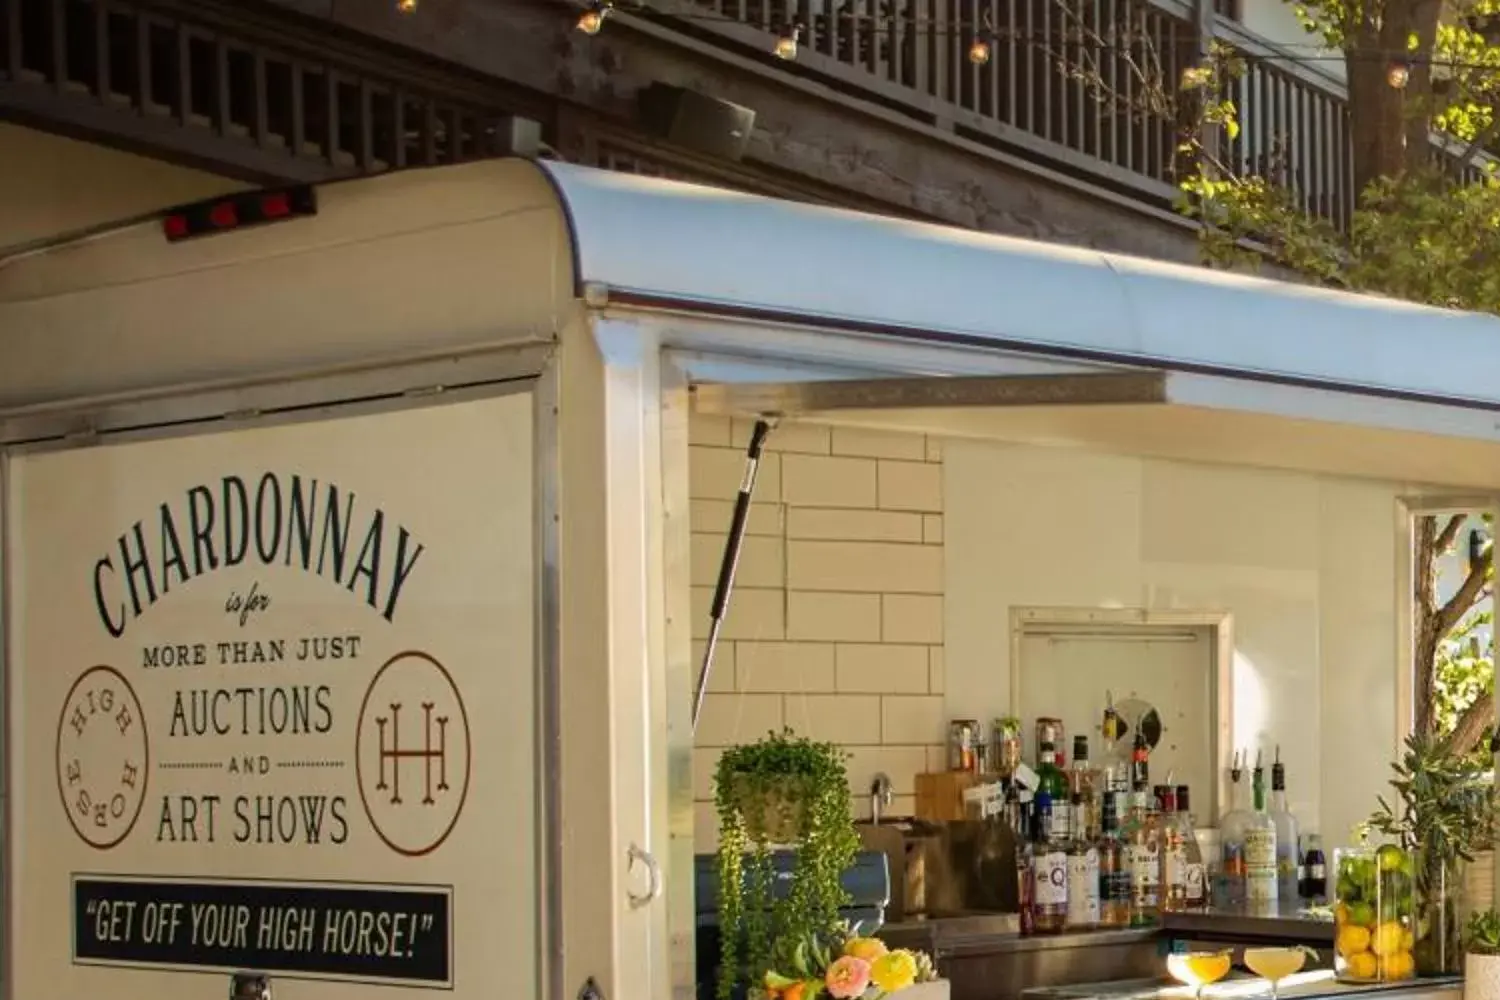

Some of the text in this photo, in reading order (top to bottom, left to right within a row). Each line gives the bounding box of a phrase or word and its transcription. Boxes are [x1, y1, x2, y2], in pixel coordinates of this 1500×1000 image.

[94, 472, 424, 638] CHARDONNAY
[225, 580, 271, 628] is for
[143, 636, 361, 668] MORE THAN JUST
[70, 688, 132, 738] HIGH
[169, 685, 333, 737] AUCTIONS
[228, 755, 270, 775] AND
[67, 758, 138, 828] HORSE
[156, 795, 350, 845] ART SHOWS
[142, 902, 184, 945] OFF
[191, 904, 249, 950] YOUR
[256, 907, 317, 952] HIGH
